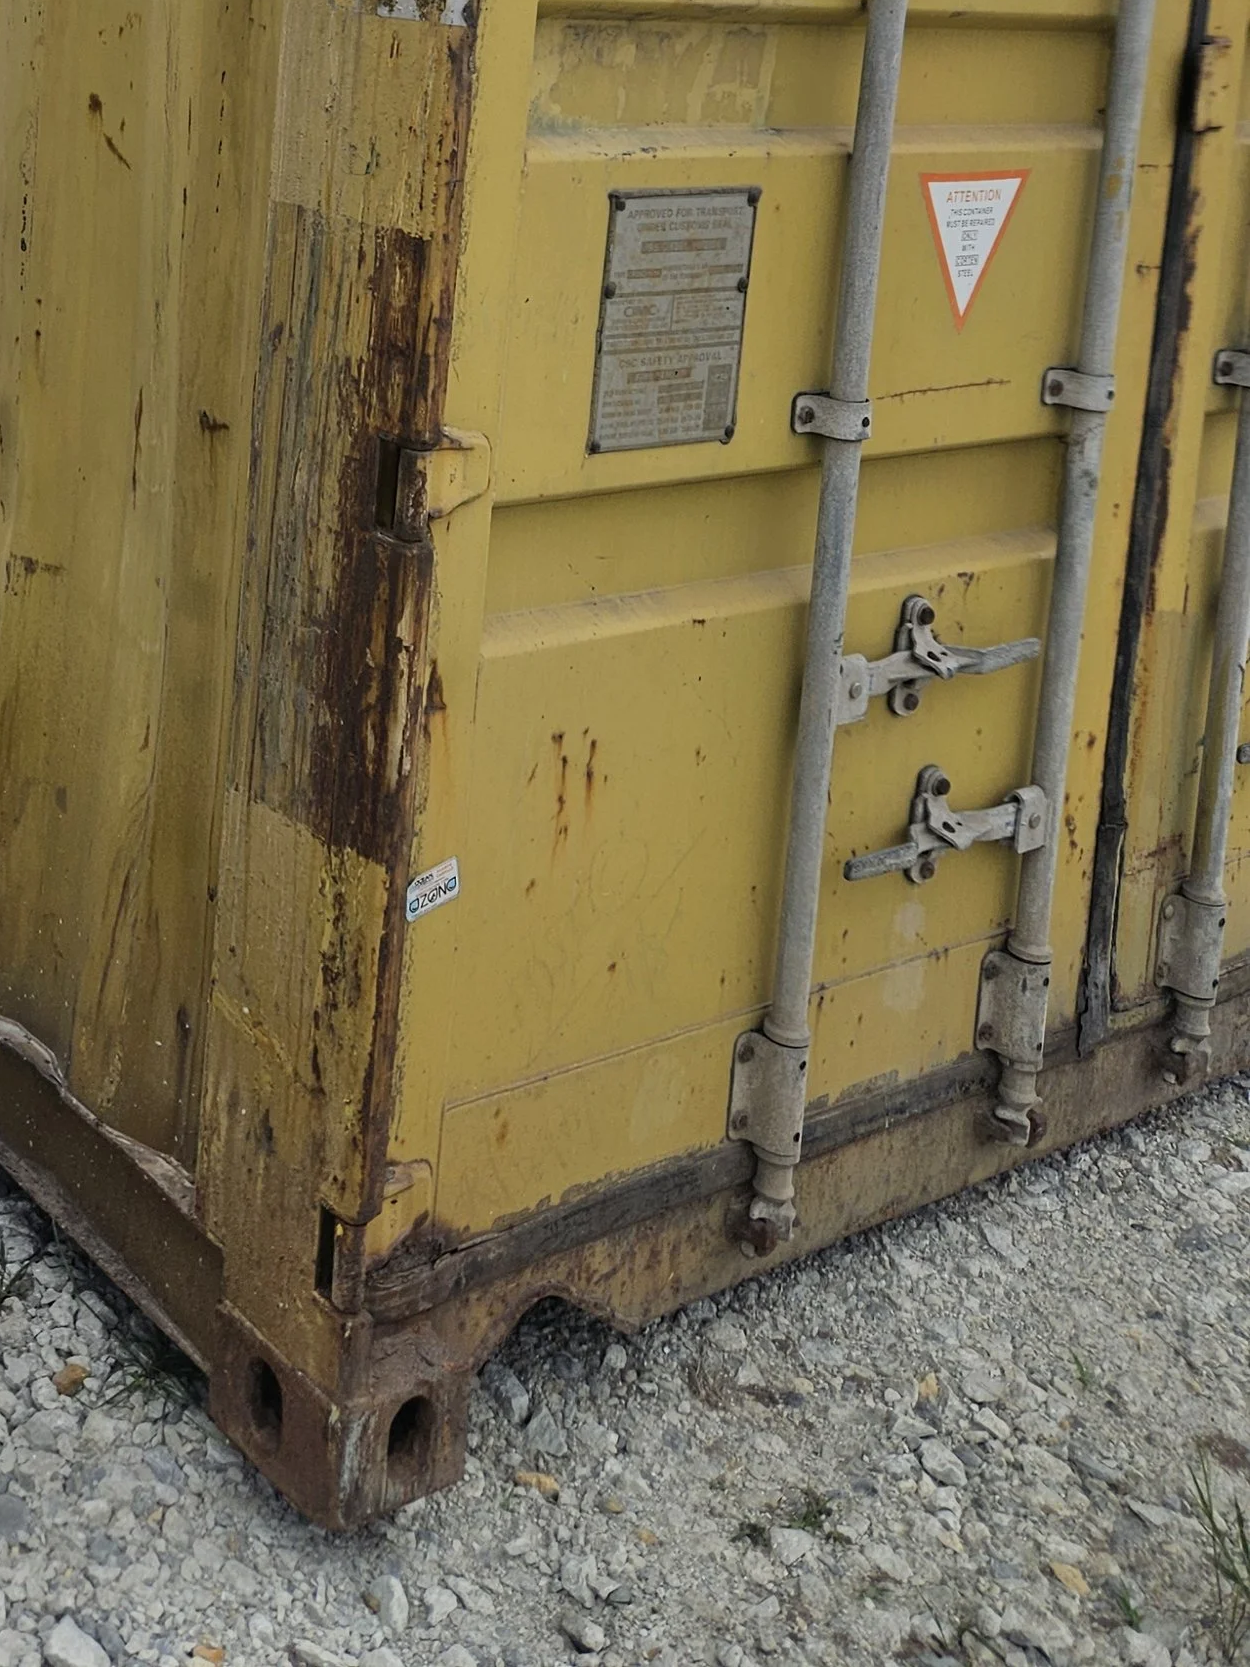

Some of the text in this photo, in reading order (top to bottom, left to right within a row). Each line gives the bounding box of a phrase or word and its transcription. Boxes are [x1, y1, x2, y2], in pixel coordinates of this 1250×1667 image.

[946, 189, 1002, 203] ATTENTION
[627, 209, 673, 219] APPROVED
[675, 207, 694, 218] FOR
[963, 206, 994, 216] CONTAINER
